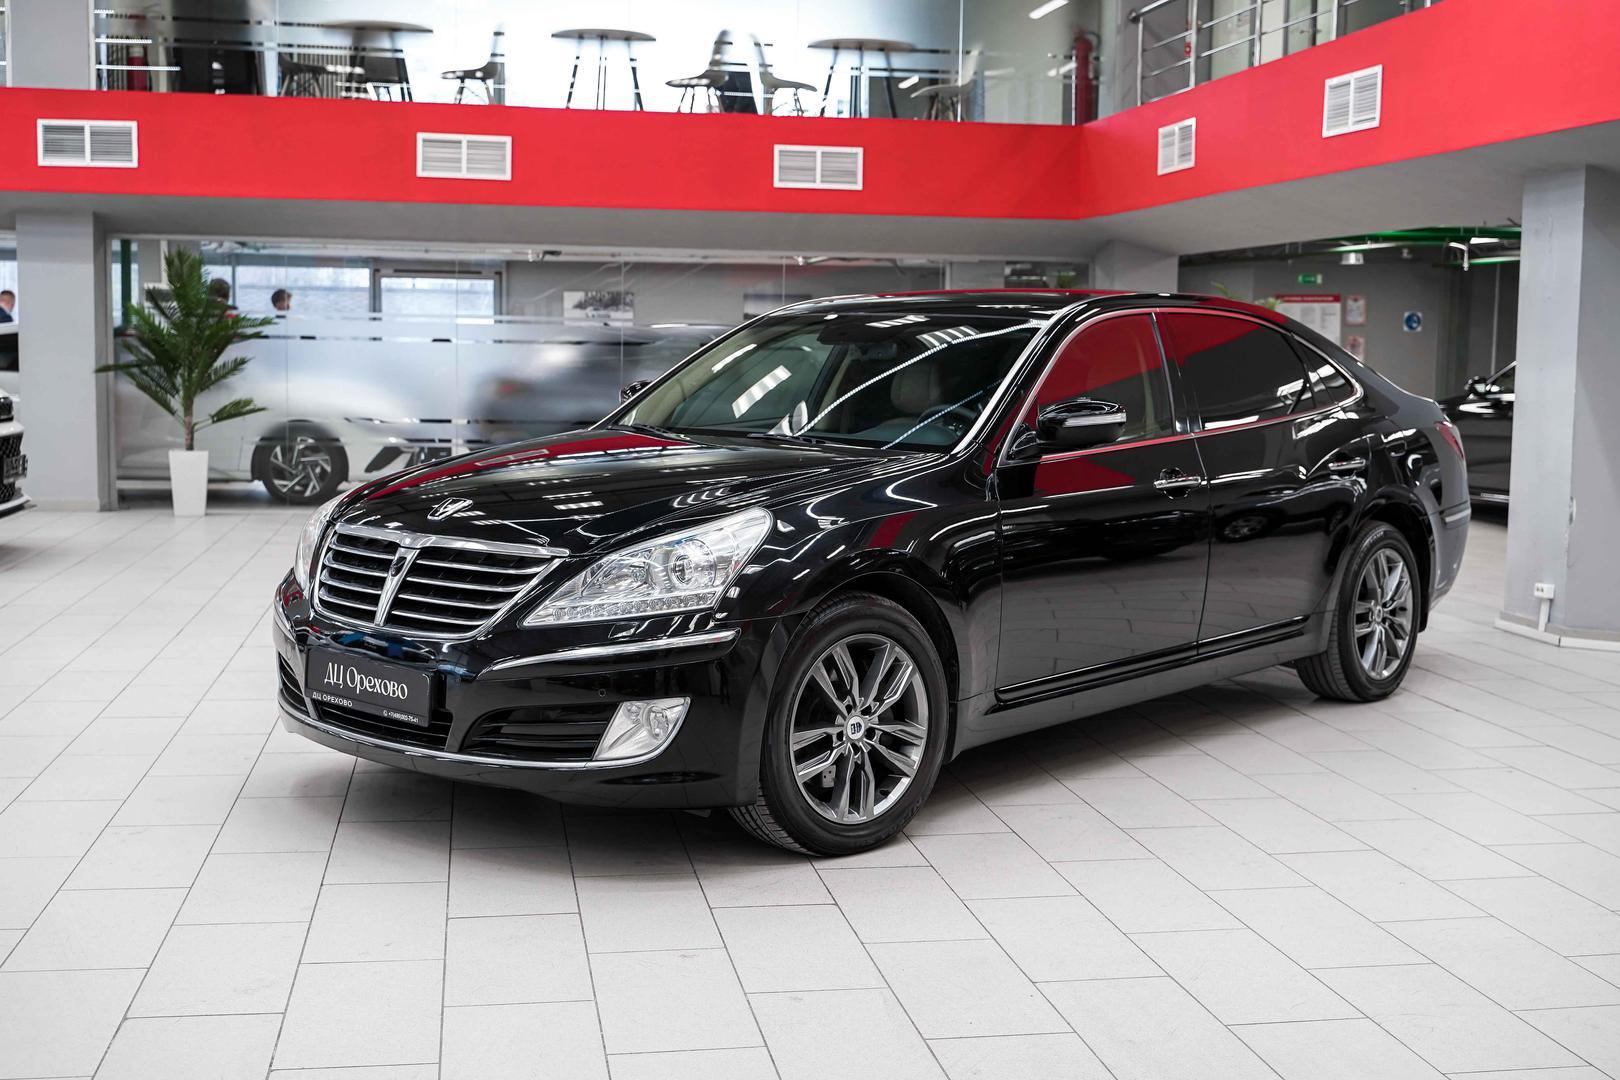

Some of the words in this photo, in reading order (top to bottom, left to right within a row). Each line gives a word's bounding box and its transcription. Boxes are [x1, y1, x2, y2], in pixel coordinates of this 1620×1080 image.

[324, 662, 344, 688] ДЦ
[346, 666, 408, 699] Орехово
[312, 691, 322, 701] ДЦ
[322, 695, 353, 707] ОРЕХОВО
